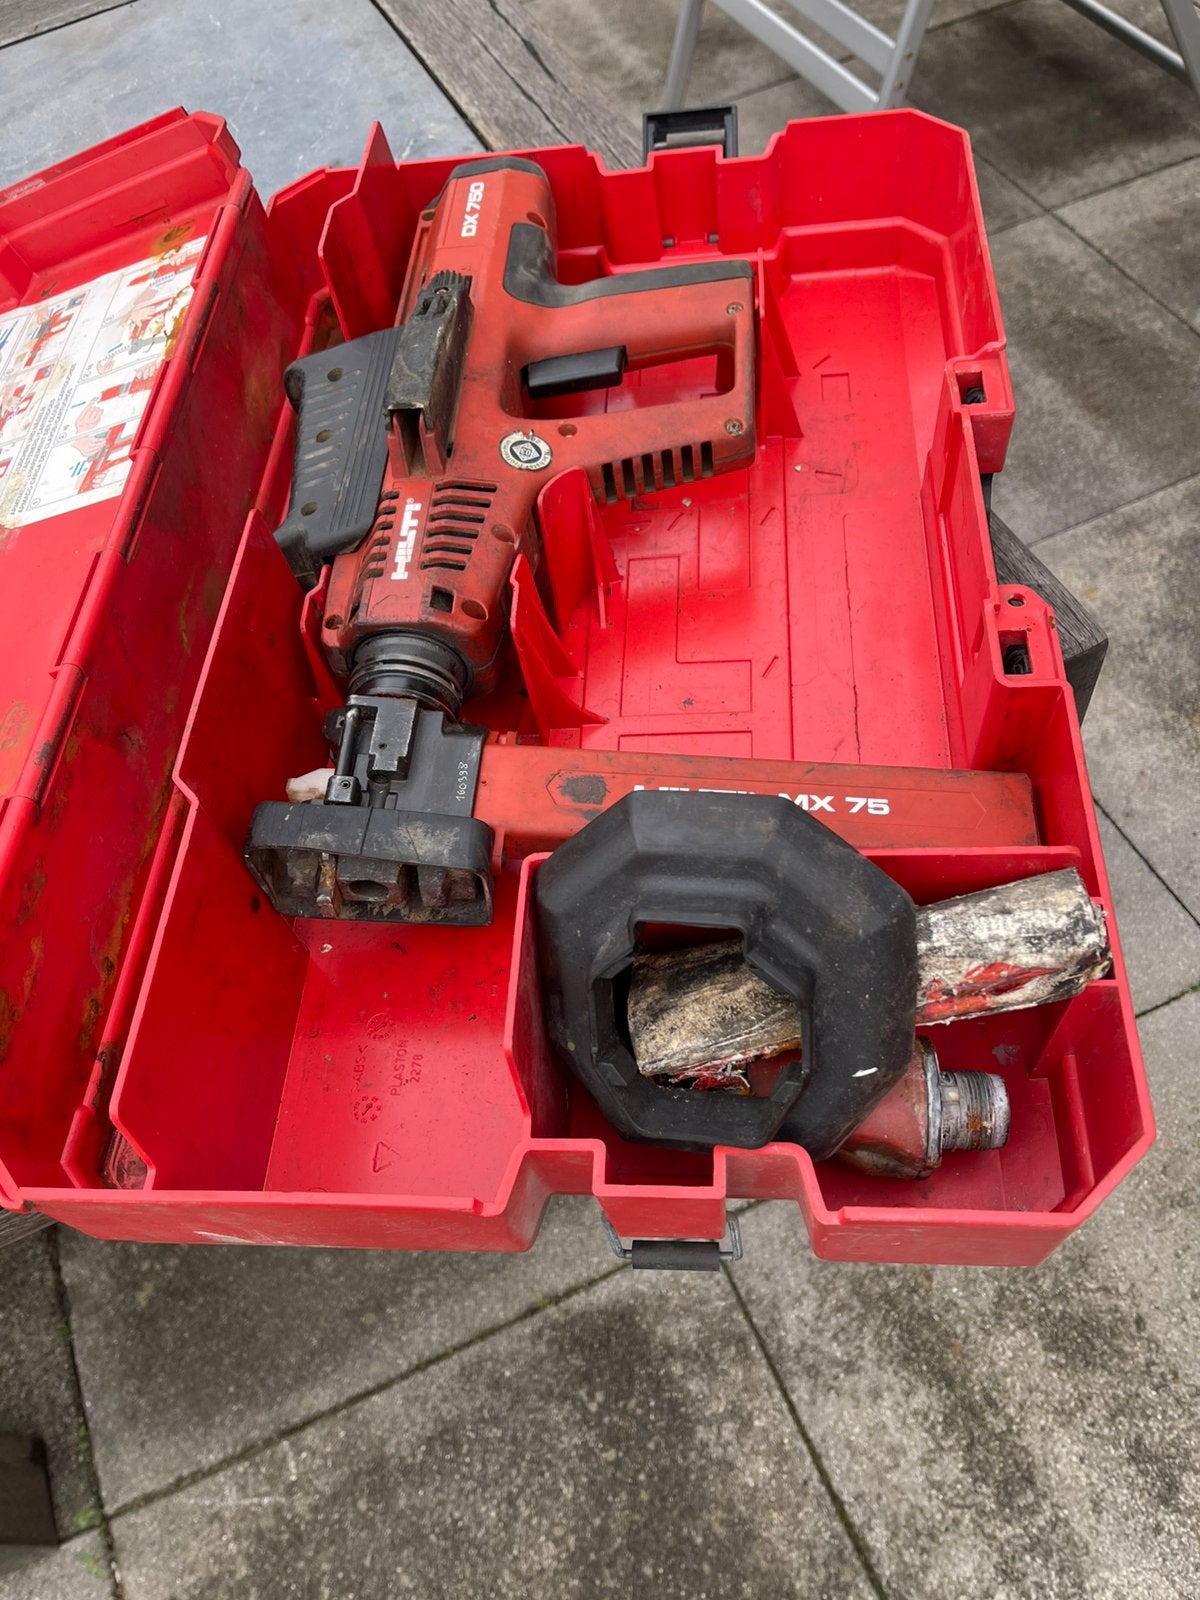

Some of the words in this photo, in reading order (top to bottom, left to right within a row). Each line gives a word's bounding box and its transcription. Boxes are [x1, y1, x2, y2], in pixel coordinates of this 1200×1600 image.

[466, 182, 485, 212] 750
[461, 213, 480, 238] DX
[456, 761, 469, 802] 160398
[778, 793, 836, 813] MX
[844, 796, 890, 816] 75
[390, 1039, 409, 1096] PLASTON
[410, 1053, 424, 1084] 2278
